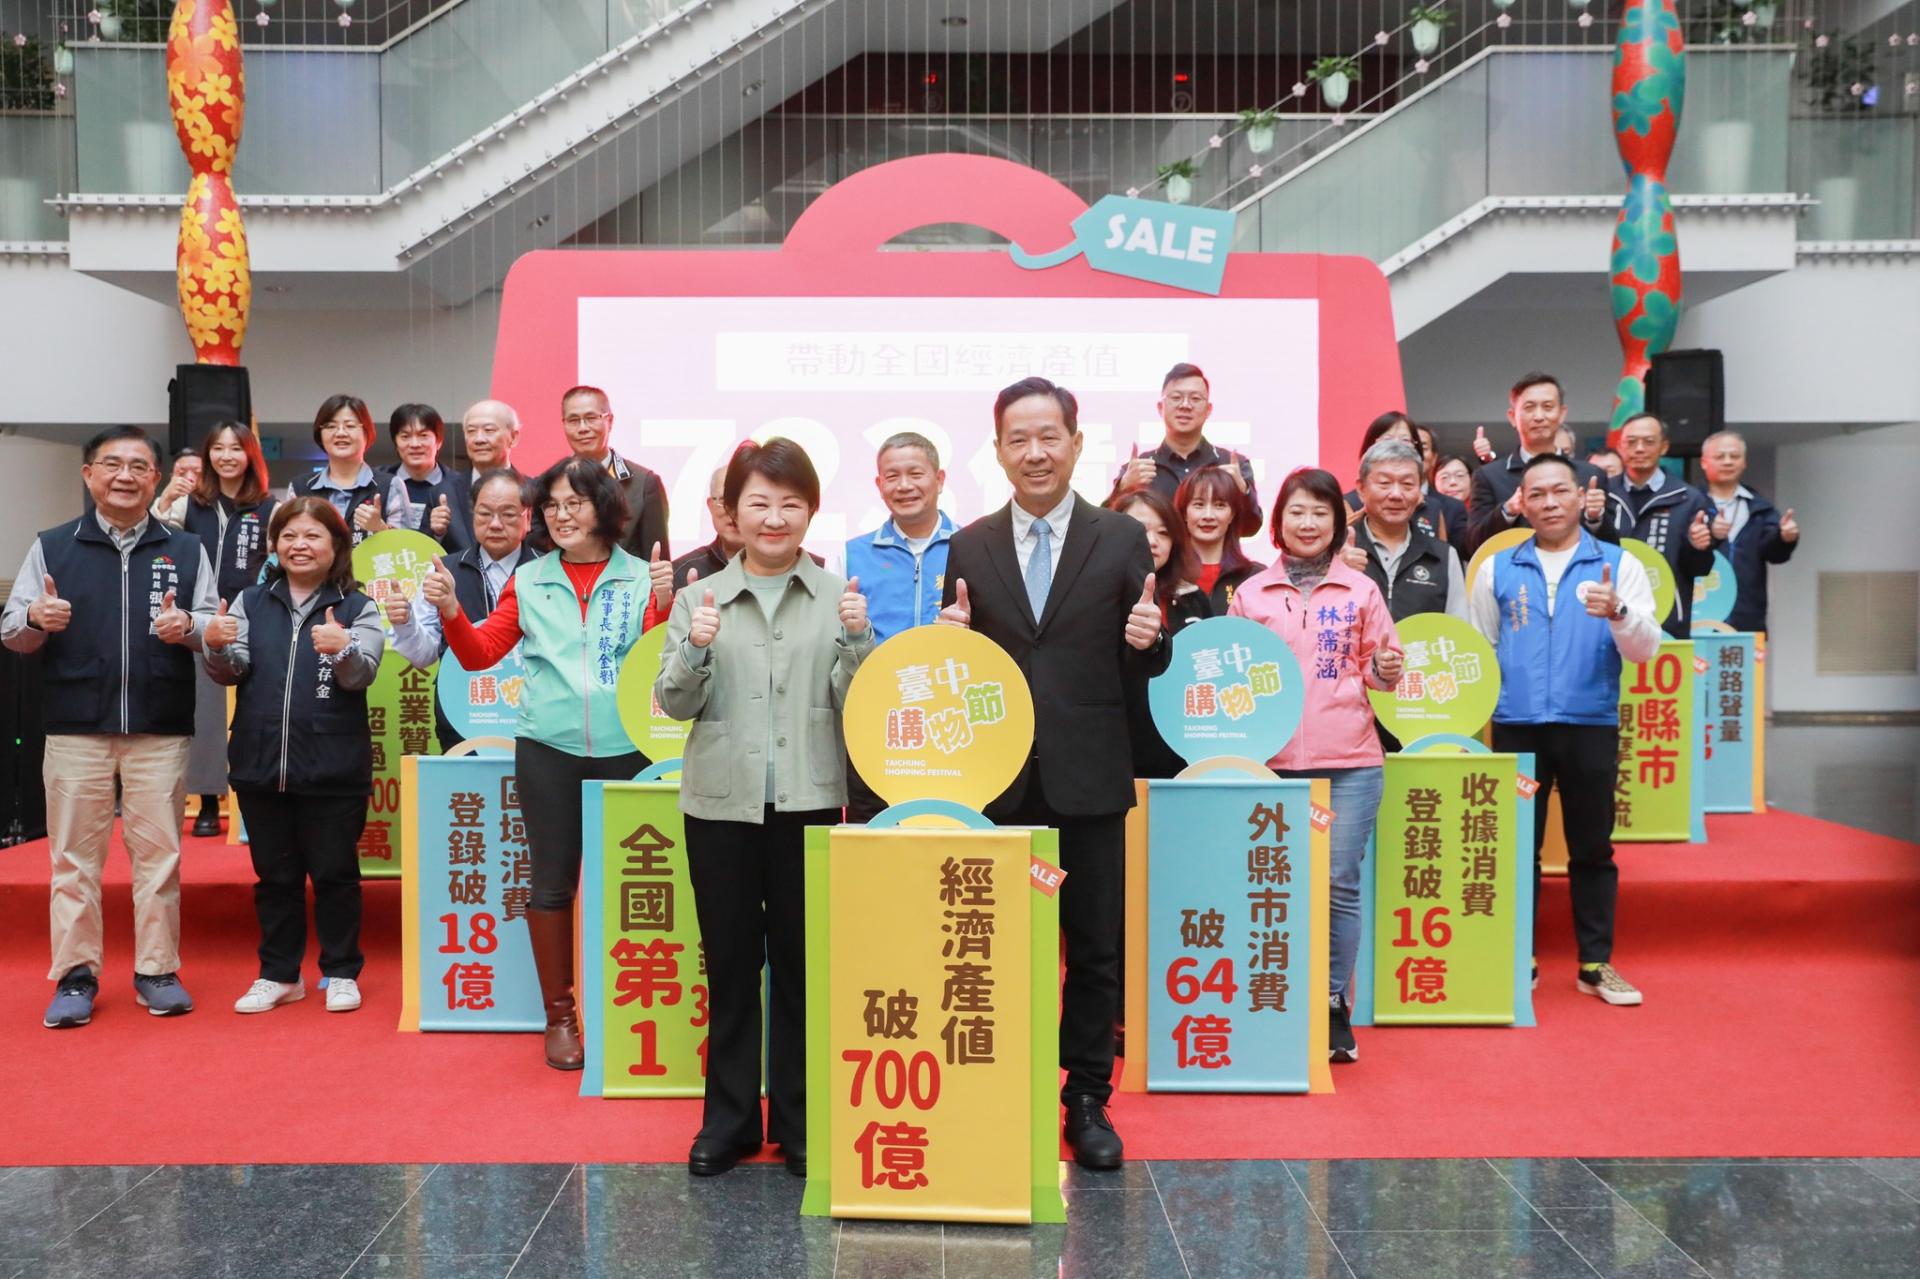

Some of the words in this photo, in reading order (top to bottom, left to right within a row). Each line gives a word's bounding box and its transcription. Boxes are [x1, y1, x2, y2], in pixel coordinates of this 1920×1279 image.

[1104, 213, 1217, 264] SALE
[784, 343, 1121, 377] 帶動全國經濟產值
[600, 589, 615, 632] 理事長
[1190, 643, 1252, 681] 臺中
[1404, 636, 1456, 669] 臺中
[469, 674, 525, 709] 購物
[895, 658, 970, 705] 臺中
[1184, 661, 1282, 721] 購物節
[1395, 652, 1482, 705] 購物節
[1719, 645, 1744, 742] 網路聲量
[885, 681, 1007, 755] 購物節
[1629, 653, 1682, 790] 10縣市
[885, 759, 927, 767] TAICHUNG
[885, 768, 926, 777] SHOPPING
[927, 768, 963, 777] FESTIVAL
[1460, 772, 1500, 917] 收據消費
[1030, 862, 1059, 888] ALE
[1247, 802, 1291, 1013] 外縣市消費
[939, 856, 996, 1066] 經濟產值
